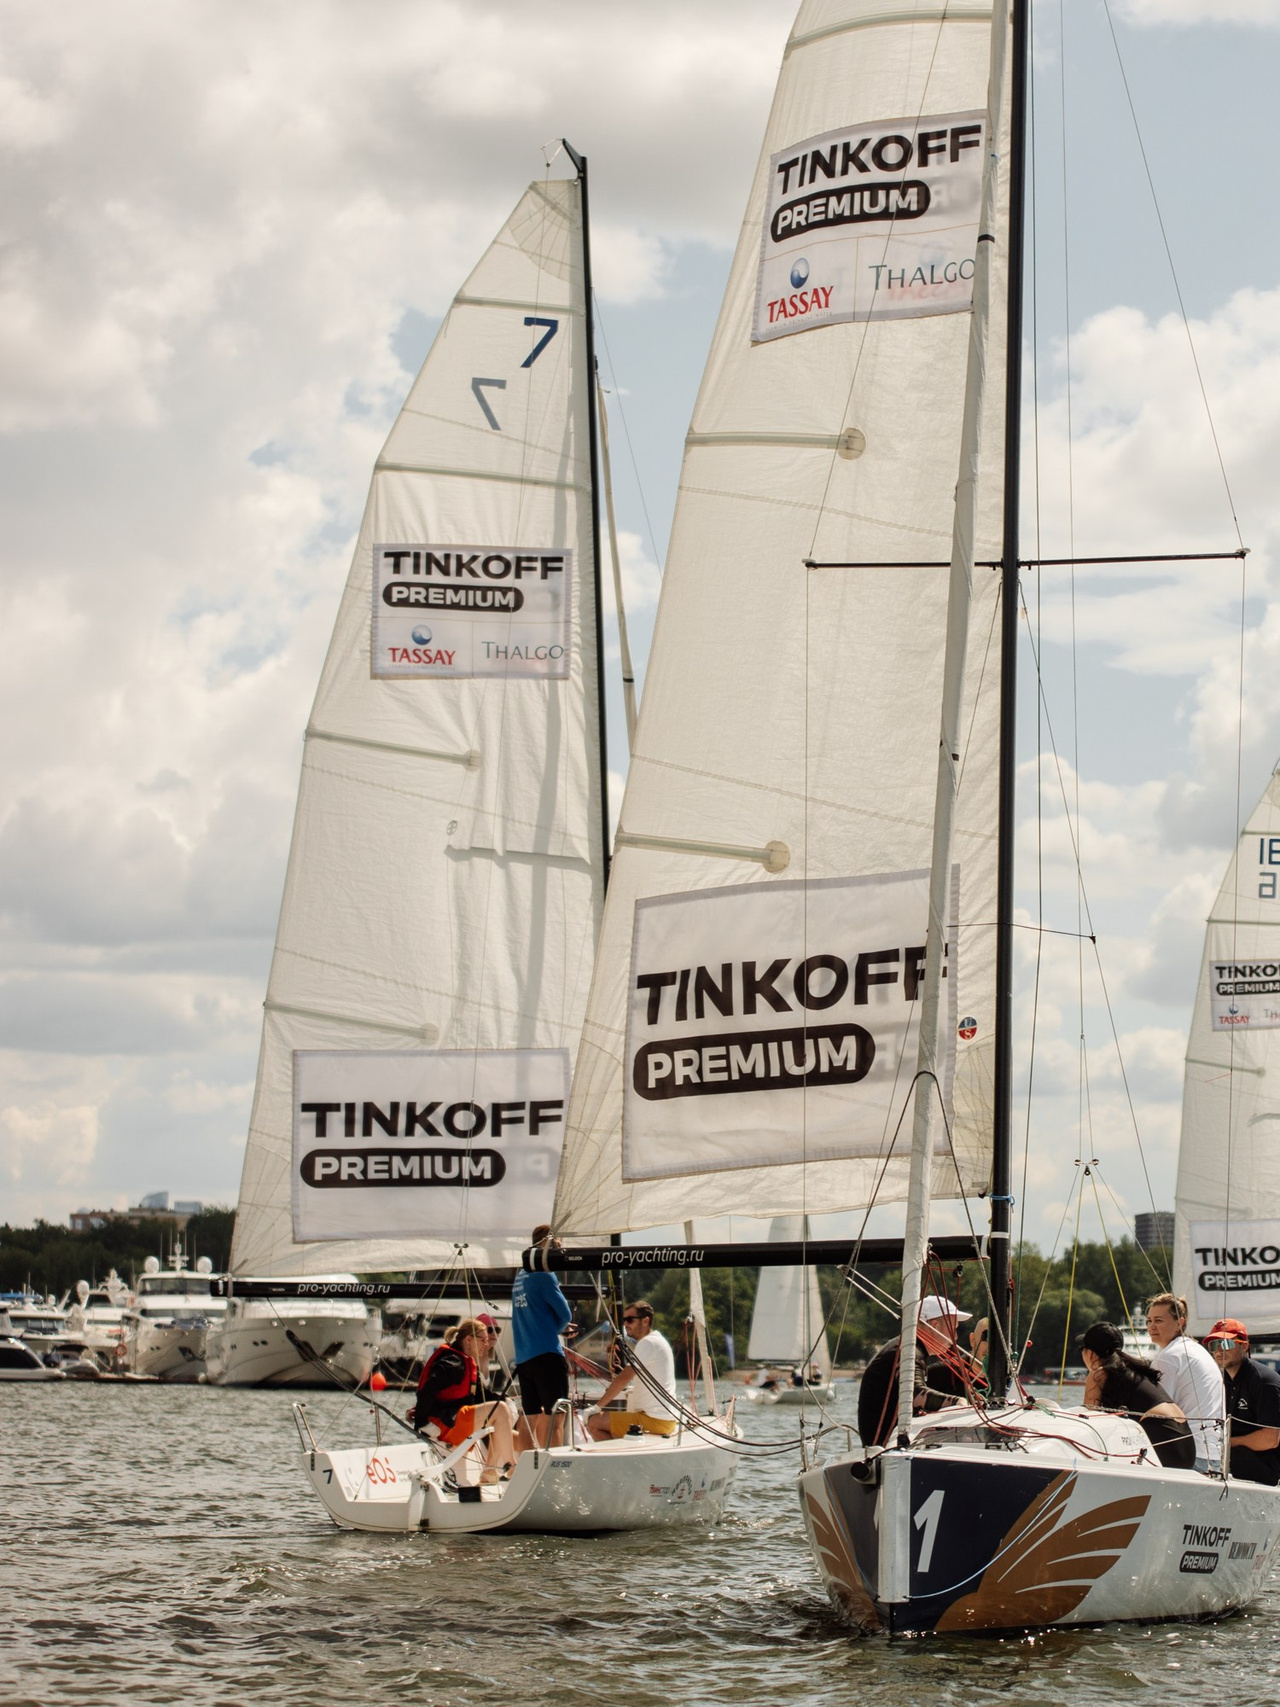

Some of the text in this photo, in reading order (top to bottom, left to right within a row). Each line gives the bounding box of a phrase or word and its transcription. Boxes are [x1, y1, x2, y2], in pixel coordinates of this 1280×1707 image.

[776, 124, 982, 196] TINKOFF
[776, 186, 918, 236] PREMIUM
[868, 258, 976, 291] THALGO
[767, 285, 834, 323] TASSAY
[520, 316, 559, 369] 7
[383, 551, 564, 581] TINKOFF
[391, 586, 515, 609] PREMIUM
[388, 647, 456, 665] TASSAY
[481, 641, 564, 660] THALGO
[1219, 982, 1280, 995] PREMIUM
[1219, 1015, 1251, 1025] TASSAY
[647, 1034, 857, 1089] PREMIUM
[301, 1100, 564, 1139] TINKOFF
[314, 1155, 492, 1181] PREMIUM
[601, 1247, 705, 1267] pro-yachting.ru
[297, 1283, 391, 1296] pro-yachting.ru
[322, 1468, 333, 1484] 7
[913, 1489, 945, 1573] 1
[1182, 1524, 1232, 1548] TINKOFF
[1181, 1554, 1218, 1570] PREMIUM
